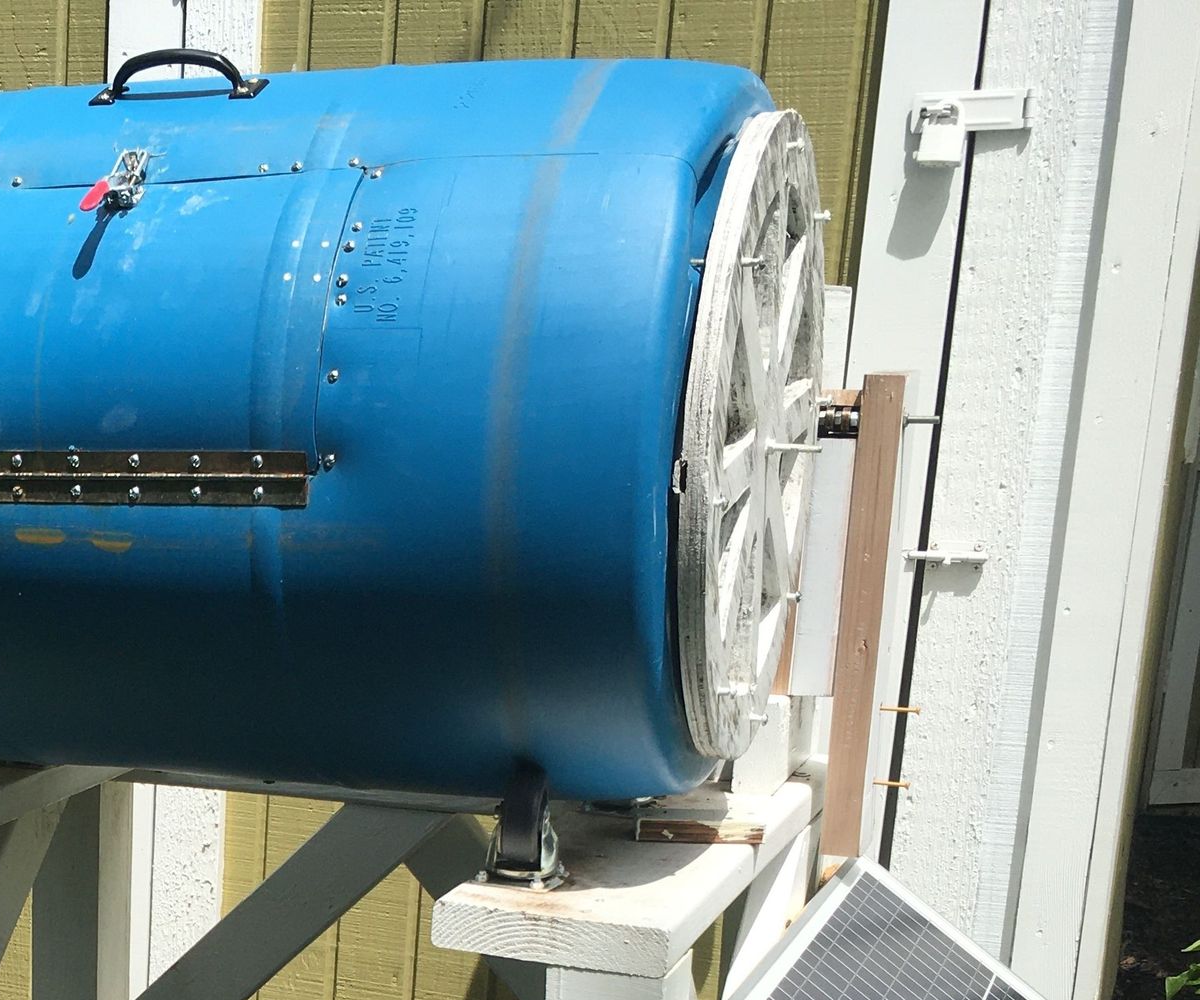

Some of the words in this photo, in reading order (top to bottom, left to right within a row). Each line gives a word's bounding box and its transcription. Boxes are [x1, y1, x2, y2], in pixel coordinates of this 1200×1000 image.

[361, 218, 392, 267] PATENT
[354, 279, 380, 313] U.S.
[376, 297, 400, 322] NO.
